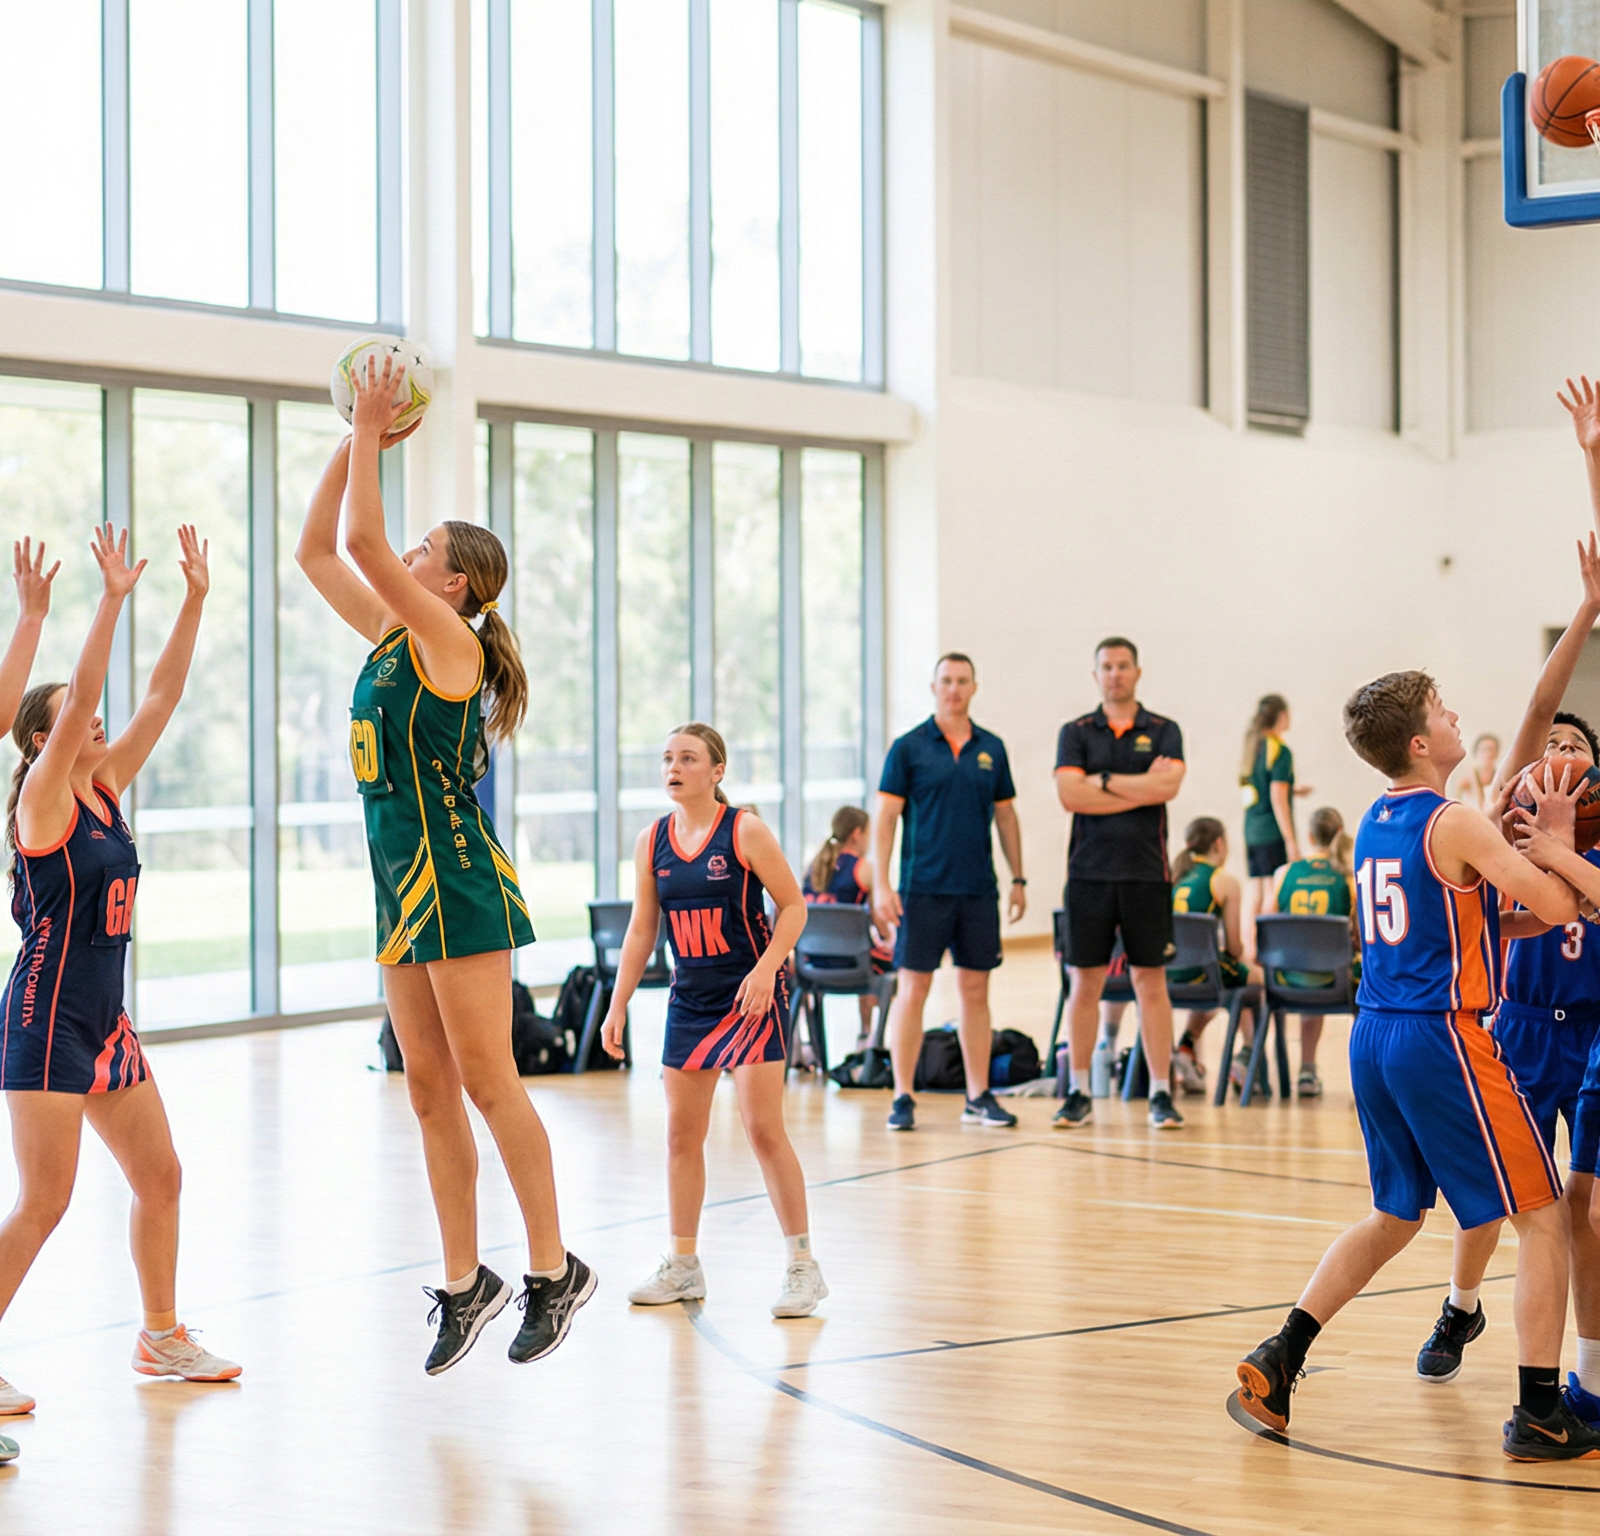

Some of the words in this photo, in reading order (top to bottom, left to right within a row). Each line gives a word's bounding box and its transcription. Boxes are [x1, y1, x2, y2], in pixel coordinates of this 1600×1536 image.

[350, 719, 378, 782] GD
[1357, 858, 1410, 946] 15
[669, 907, 731, 958] WK
[1560, 921, 1586, 961] 3
